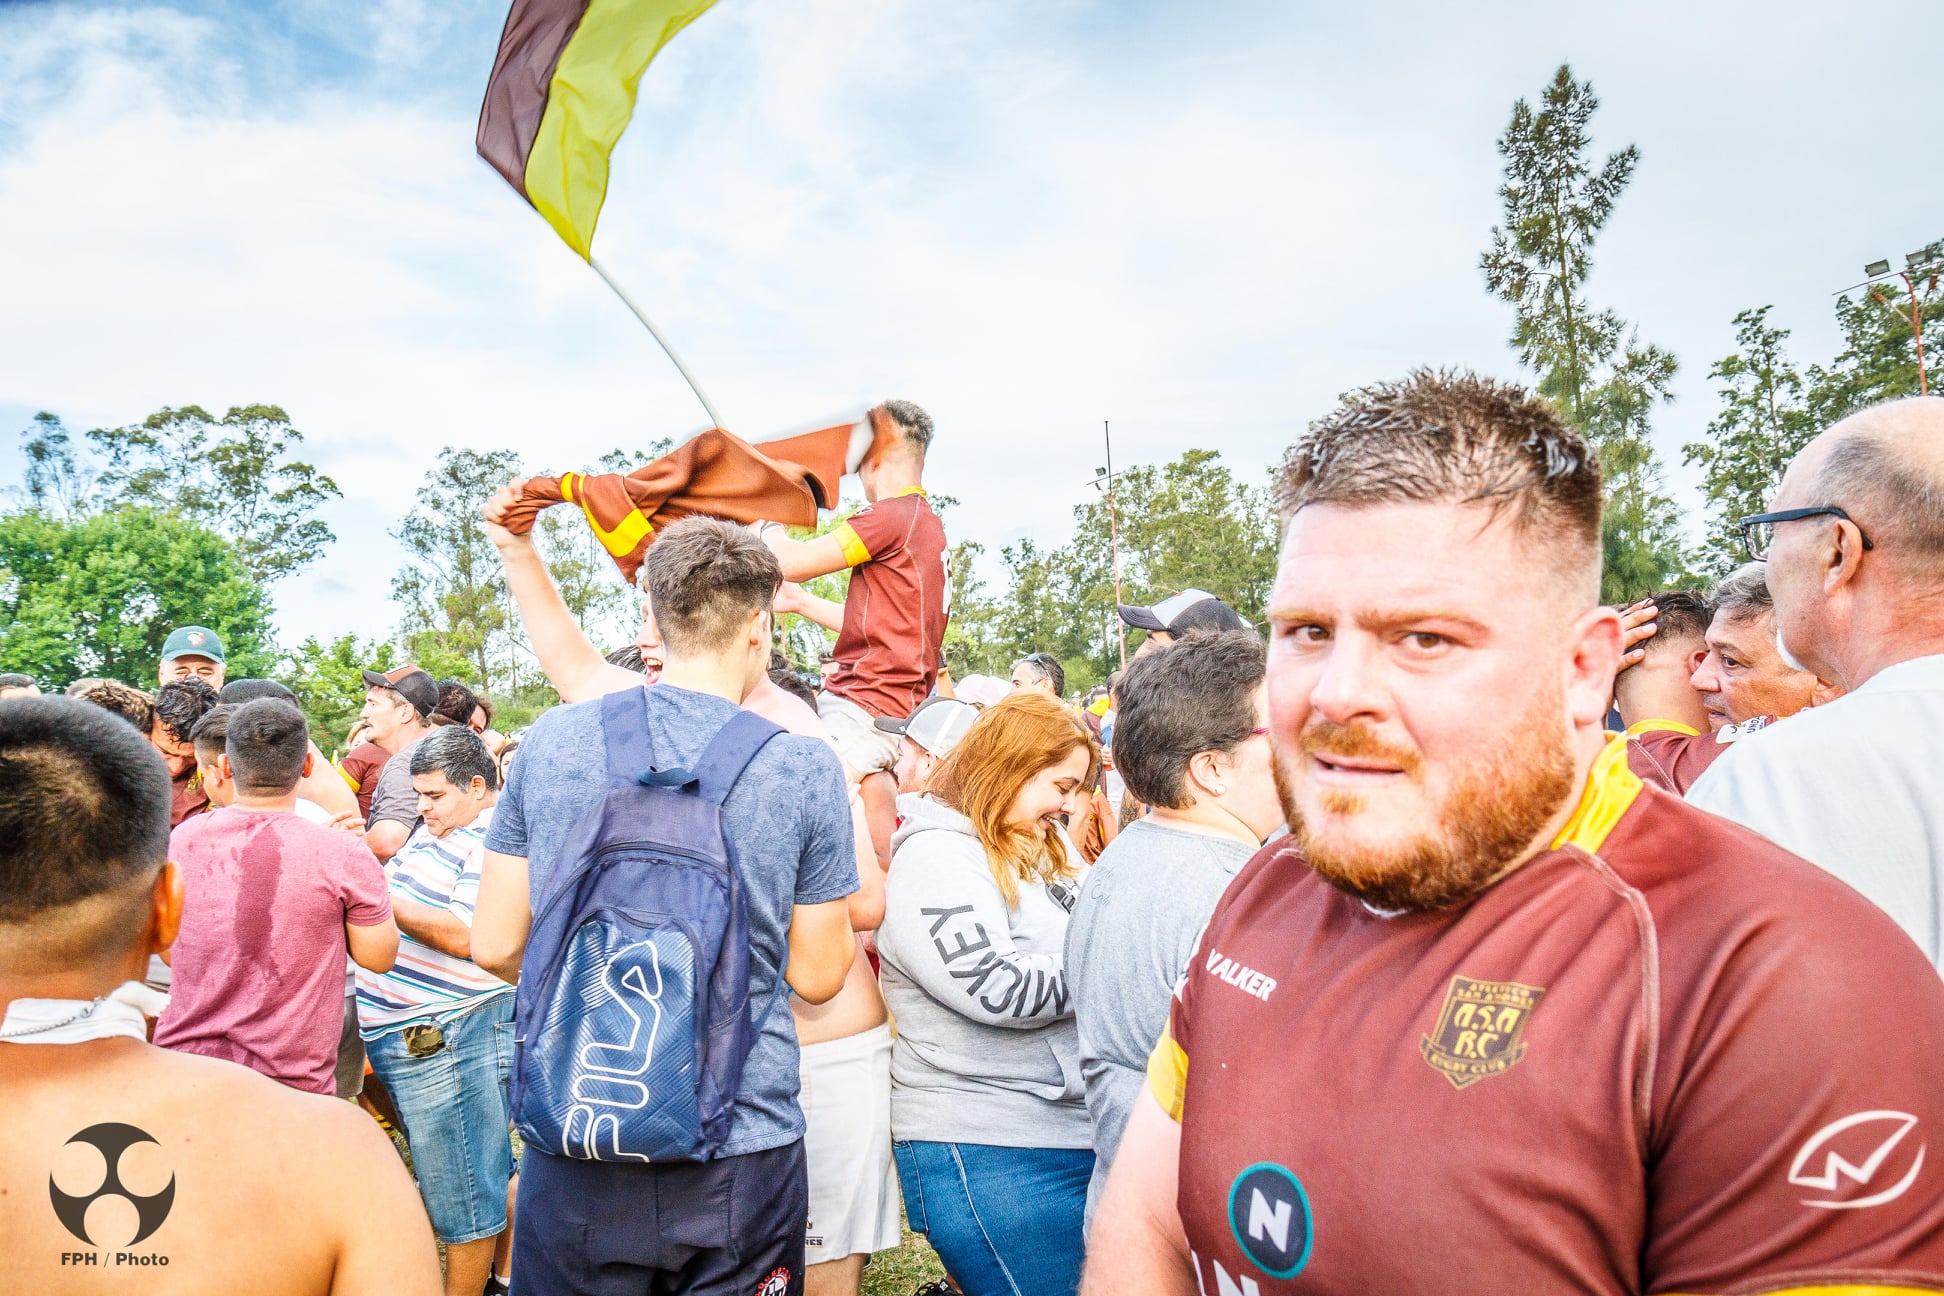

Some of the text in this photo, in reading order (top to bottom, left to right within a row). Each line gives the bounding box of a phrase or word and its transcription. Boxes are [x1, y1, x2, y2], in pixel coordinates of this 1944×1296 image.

[920, 904, 1069, 1018] MICKEY
[1205, 947, 1278, 1002] VALKER
[562, 939, 663, 1163] FILA
[1248, 1186, 1292, 1254] N
